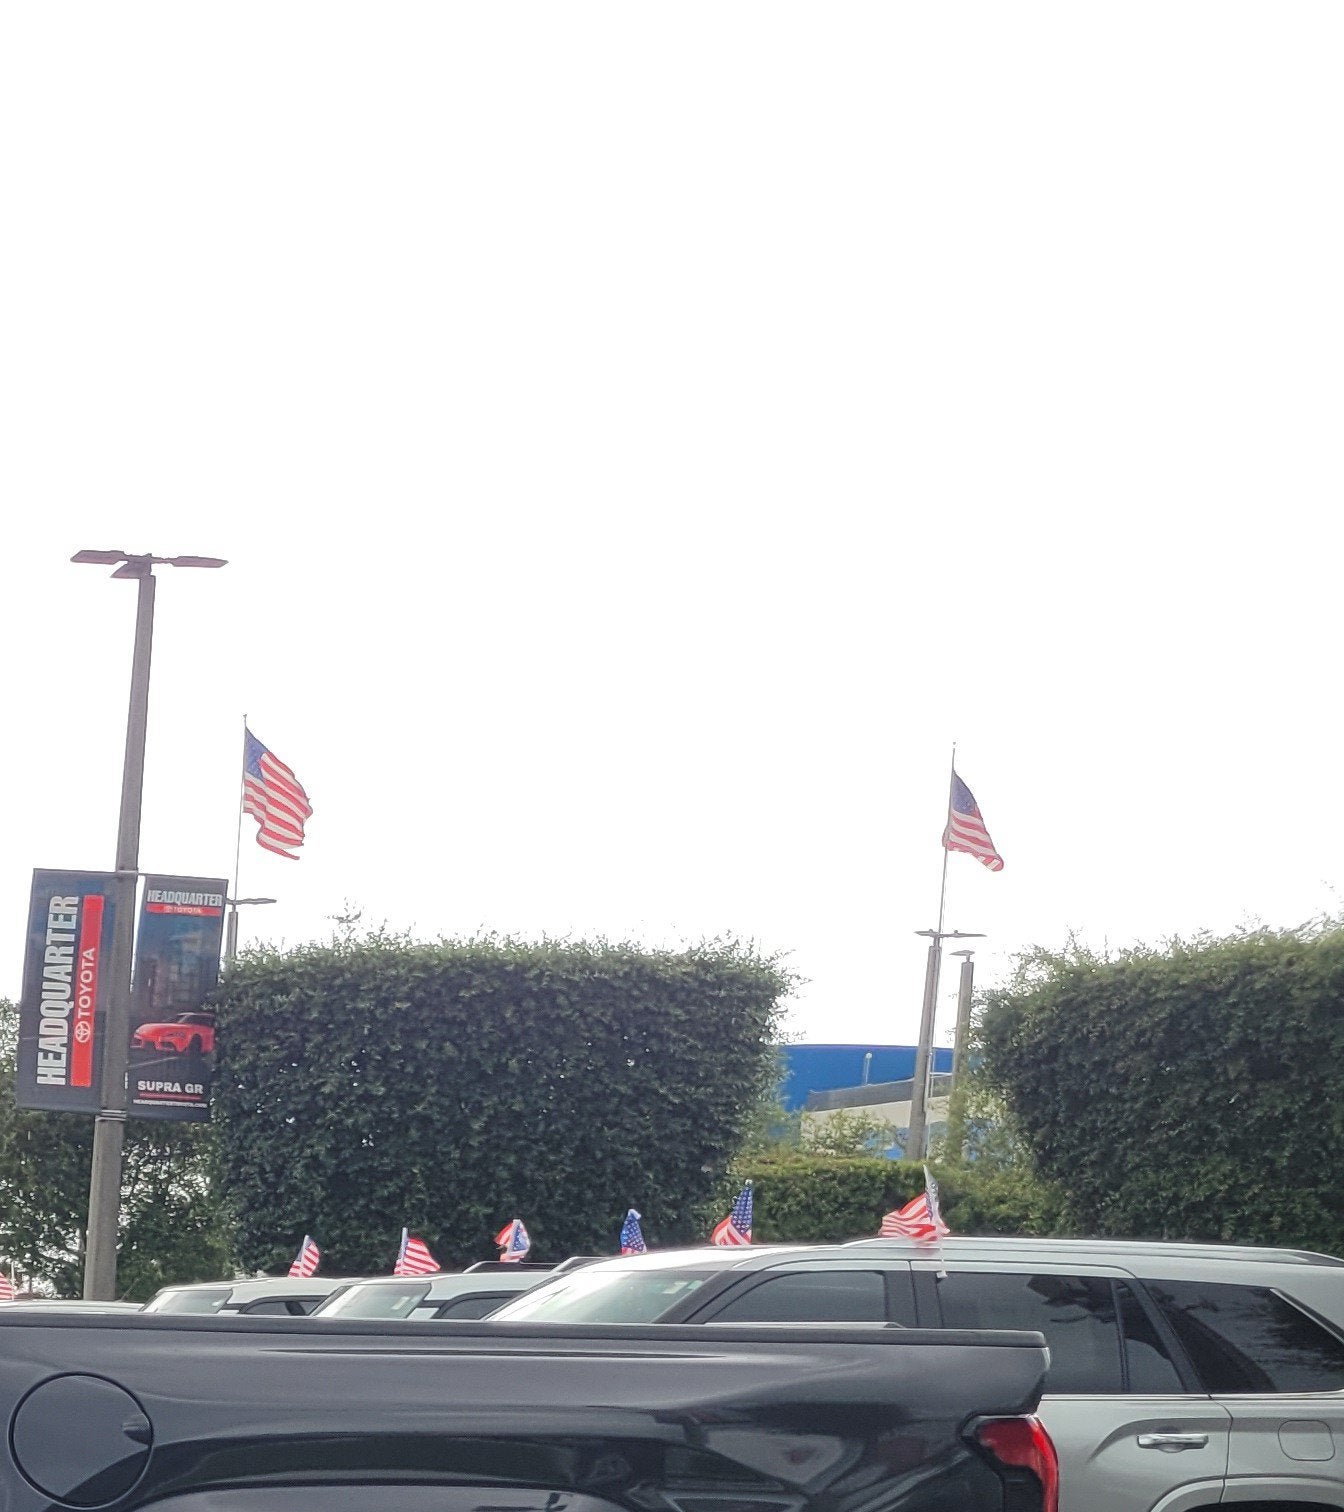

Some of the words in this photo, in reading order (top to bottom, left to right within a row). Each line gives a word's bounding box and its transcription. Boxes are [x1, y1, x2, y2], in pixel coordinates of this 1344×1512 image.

[147, 889, 223, 907] HEADQUARTER
[36, 895, 79, 1086] HEADQUARTER
[78, 948, 96, 1019] TOYOTA
[137, 1080, 182, 1093] SUPRA
[184, 1083, 204, 1094] GR
